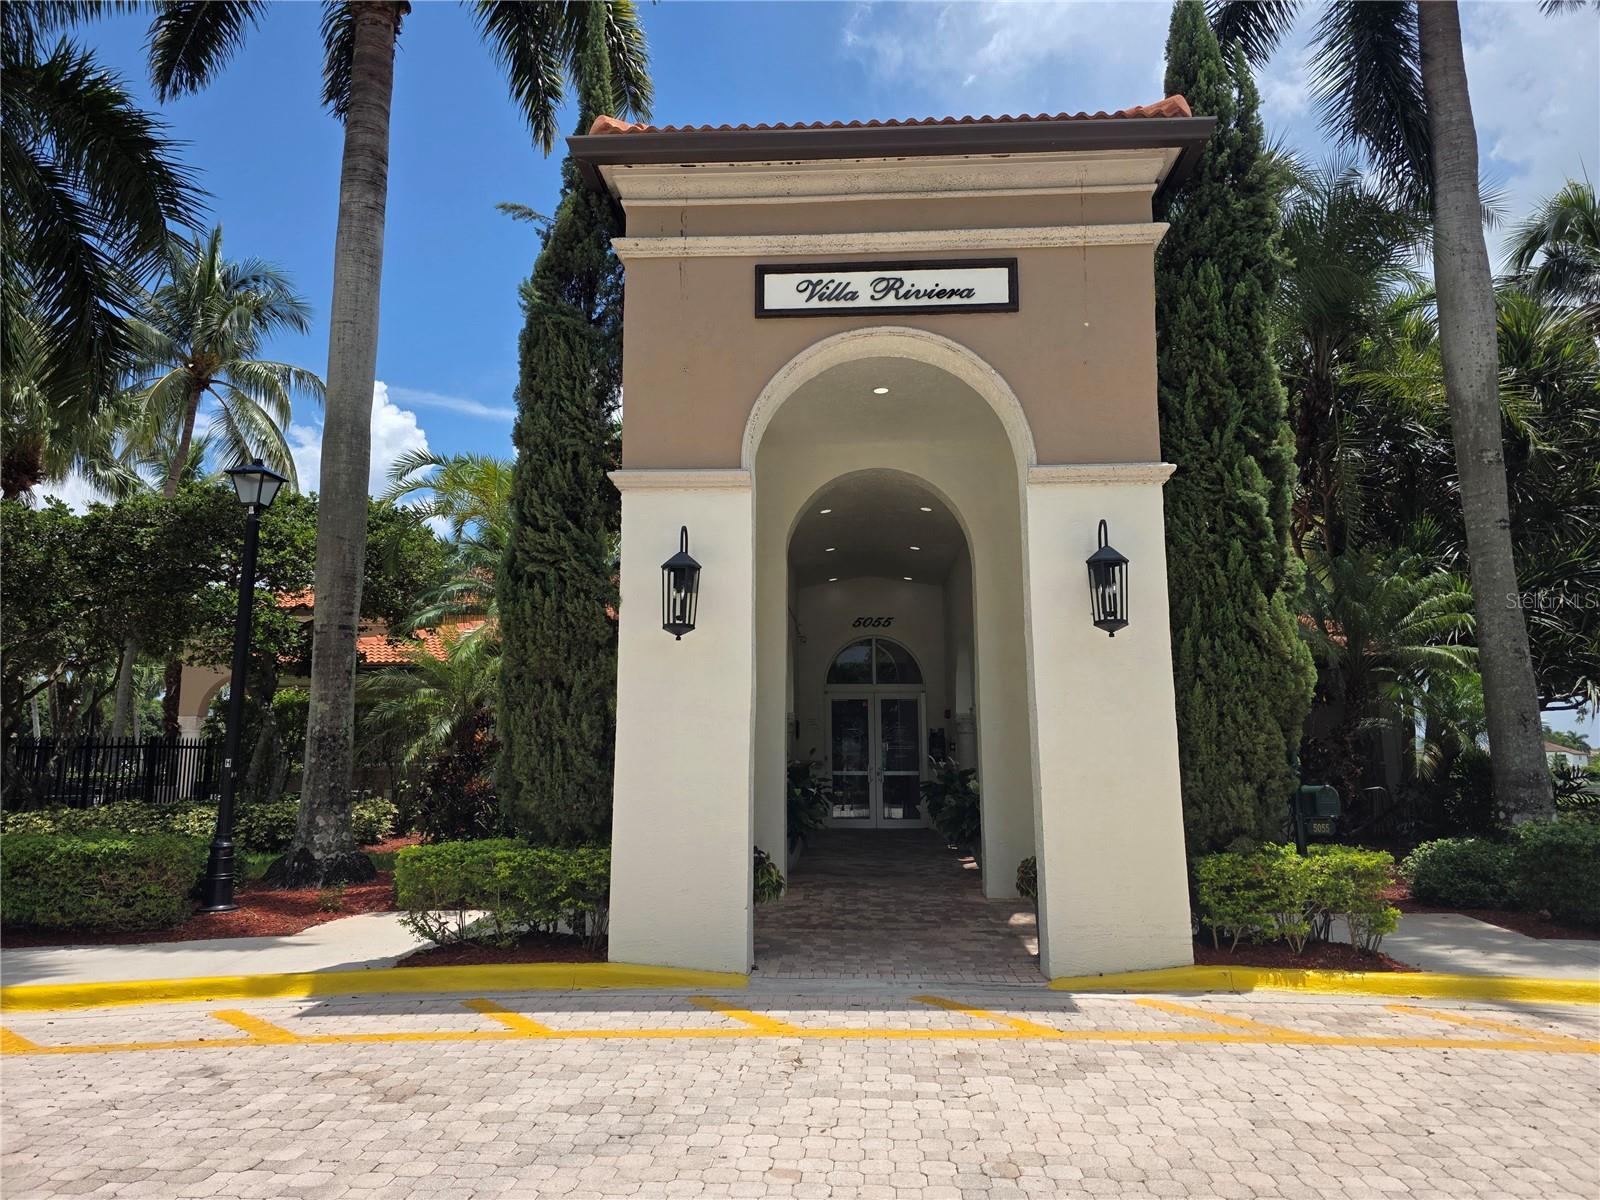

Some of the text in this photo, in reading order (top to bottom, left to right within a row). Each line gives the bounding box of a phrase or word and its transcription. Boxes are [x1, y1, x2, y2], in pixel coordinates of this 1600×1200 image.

[796, 277, 976, 303] Villa Riviera
[852, 616, 894, 628] 5055
[1312, 823, 1330, 833] 5055
